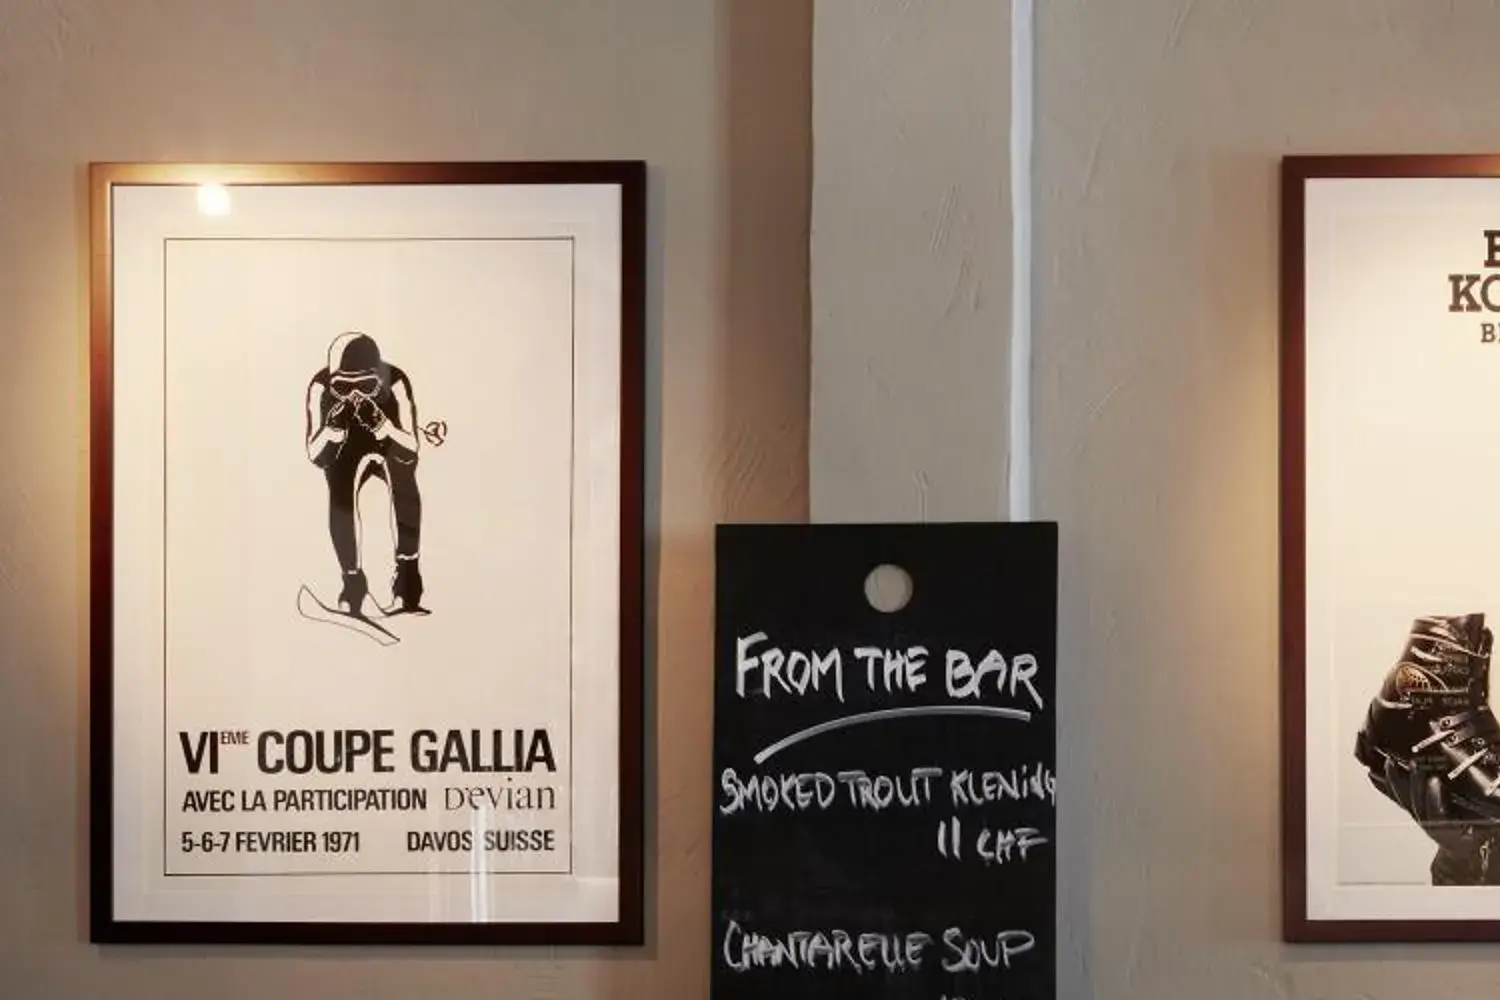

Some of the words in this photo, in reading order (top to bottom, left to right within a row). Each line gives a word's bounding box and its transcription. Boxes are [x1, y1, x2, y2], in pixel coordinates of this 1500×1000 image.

[736, 631, 845, 704] FROM
[853, 645, 930, 693] THE
[945, 648, 1044, 711] BAR
[257, 729, 395, 775] COUPE
[410, 729, 557, 773] GALLIA
[182, 789, 235, 813] AVEC
[241, 789, 267, 812] LA
[273, 788, 427, 812] PARTICIPATION
[720, 767, 835, 815] SMOKED
[837, 767, 943, 813] TROUT
[181, 831, 231, 853] 5-6-7
[235, 831, 317, 853] FEVRIER
[321, 831, 360, 853] 1971
[407, 831, 473, 852] DAVOS
[483, 830, 555, 851] SUISSE
[976, 827, 1049, 866] CHF
[941, 927, 1035, 972] SOUP
